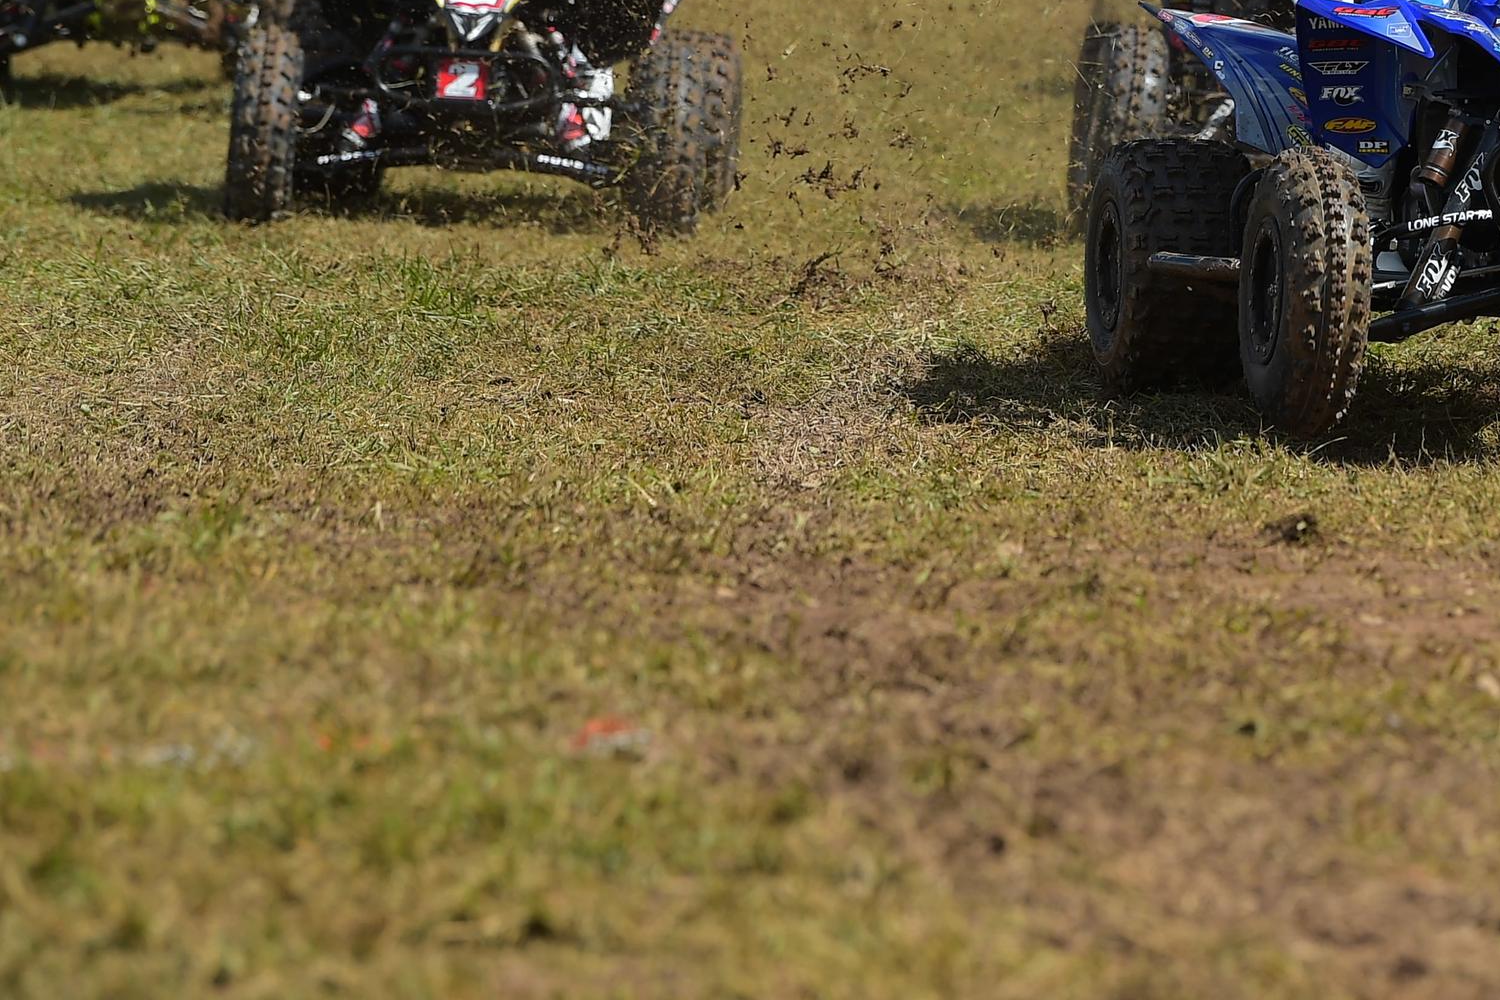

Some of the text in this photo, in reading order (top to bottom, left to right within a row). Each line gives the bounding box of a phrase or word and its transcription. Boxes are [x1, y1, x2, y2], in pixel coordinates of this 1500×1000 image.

[444, 63, 480, 97] 2
[1320, 86, 1364, 106] FOX
[1325, 120, 1376, 131] FMF
[1359, 141, 1388, 149] DP
[1408, 215, 1440, 231] LONE
[1442, 210, 1474, 224] STAR
[1415, 243, 1450, 300] FOX
